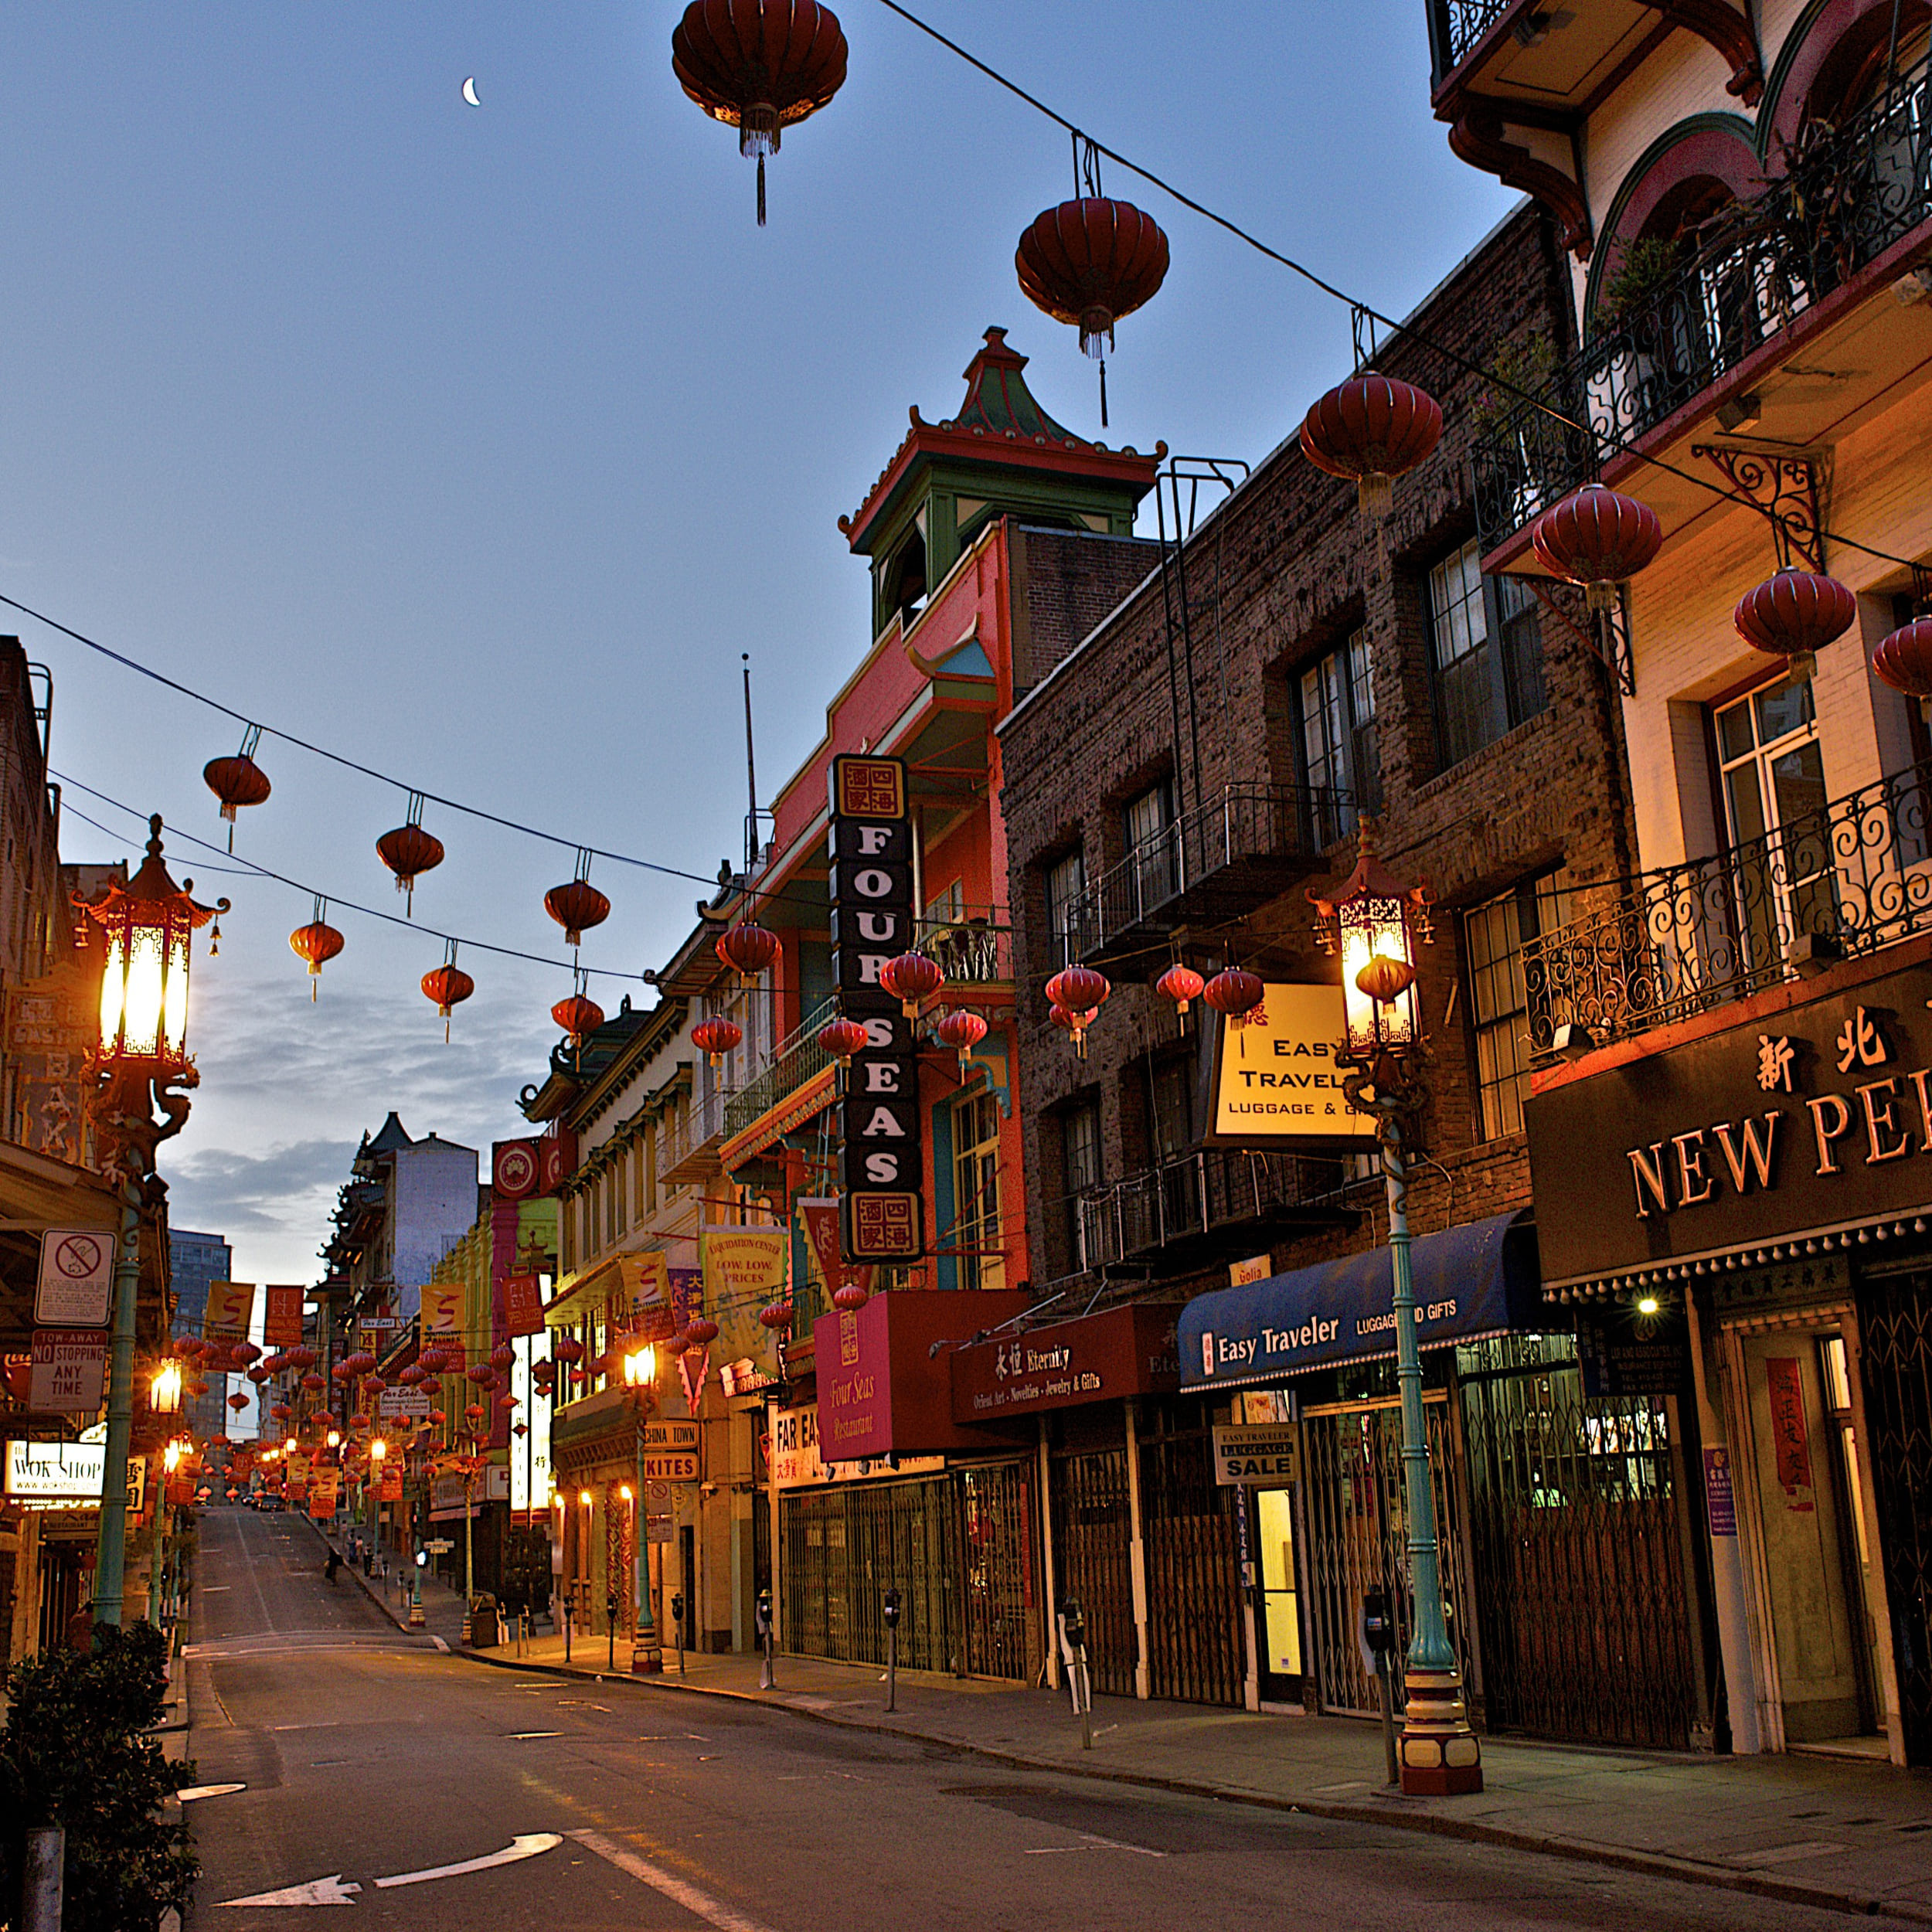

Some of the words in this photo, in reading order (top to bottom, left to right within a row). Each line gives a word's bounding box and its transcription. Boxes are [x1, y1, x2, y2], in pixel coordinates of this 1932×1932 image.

[854, 826, 896, 983] FOUR
[1239, 1070, 1343, 1088] TRAVEL
[861, 1018, 906, 1183] SEAS
[1230, 1102, 1315, 1114] LUGGAGE
[1325, 1102, 1335, 1114] &
[1627, 1111, 1782, 1219] NEW
[709, 1238, 754, 1255] LIQUIDATION
[755, 1240, 781, 1256] CENTER
[725, 1273, 764, 1283] PRICES
[1240, 1267, 1262, 1283] Golia
[1427, 1299, 1457, 1320] GIFTS
[41, 1332, 100, 1343] TOW-AWAY
[1219, 1338, 1257, 1365] Easy
[1261, 1315, 1339, 1353] Traveler
[33, 1345, 52, 1362] NO
[56, 1347, 104, 1361] STOPPING
[1027, 1344, 1070, 1372] Eternity
[54, 1366, 82, 1379] ANY
[52, 1381, 83, 1395] TIME
[830, 1379, 852, 1408] Four
[852, 1371, 874, 1404] Seas
[974, 1393, 993, 1410] Orient
[994, 1391, 1005, 1406] Art
[1011, 1383, 1039, 1403] Novelties
[1046, 1378, 1071, 1396] Jewelry
[1073, 1375, 1080, 1391] &
[1081, 1372, 1100, 1390] Gifts
[645, 1427, 667, 1444] CHINA
[673, 1427, 695, 1443] TOWN
[777, 1417, 798, 1453] FAR
[834, 1411, 872, 1444] Restaurant
[1223, 1434, 1243, 1442] EASY
[1247, 1432, 1290, 1441] TRAVELER
[1224, 1444, 1291, 1456] LUGGAGE
[15, 1459, 50, 1478] WOK
[59, 1461, 101, 1479] SHOP
[646, 1458, 693, 1476] KITES
[1226, 1458, 1291, 1476] SALE
